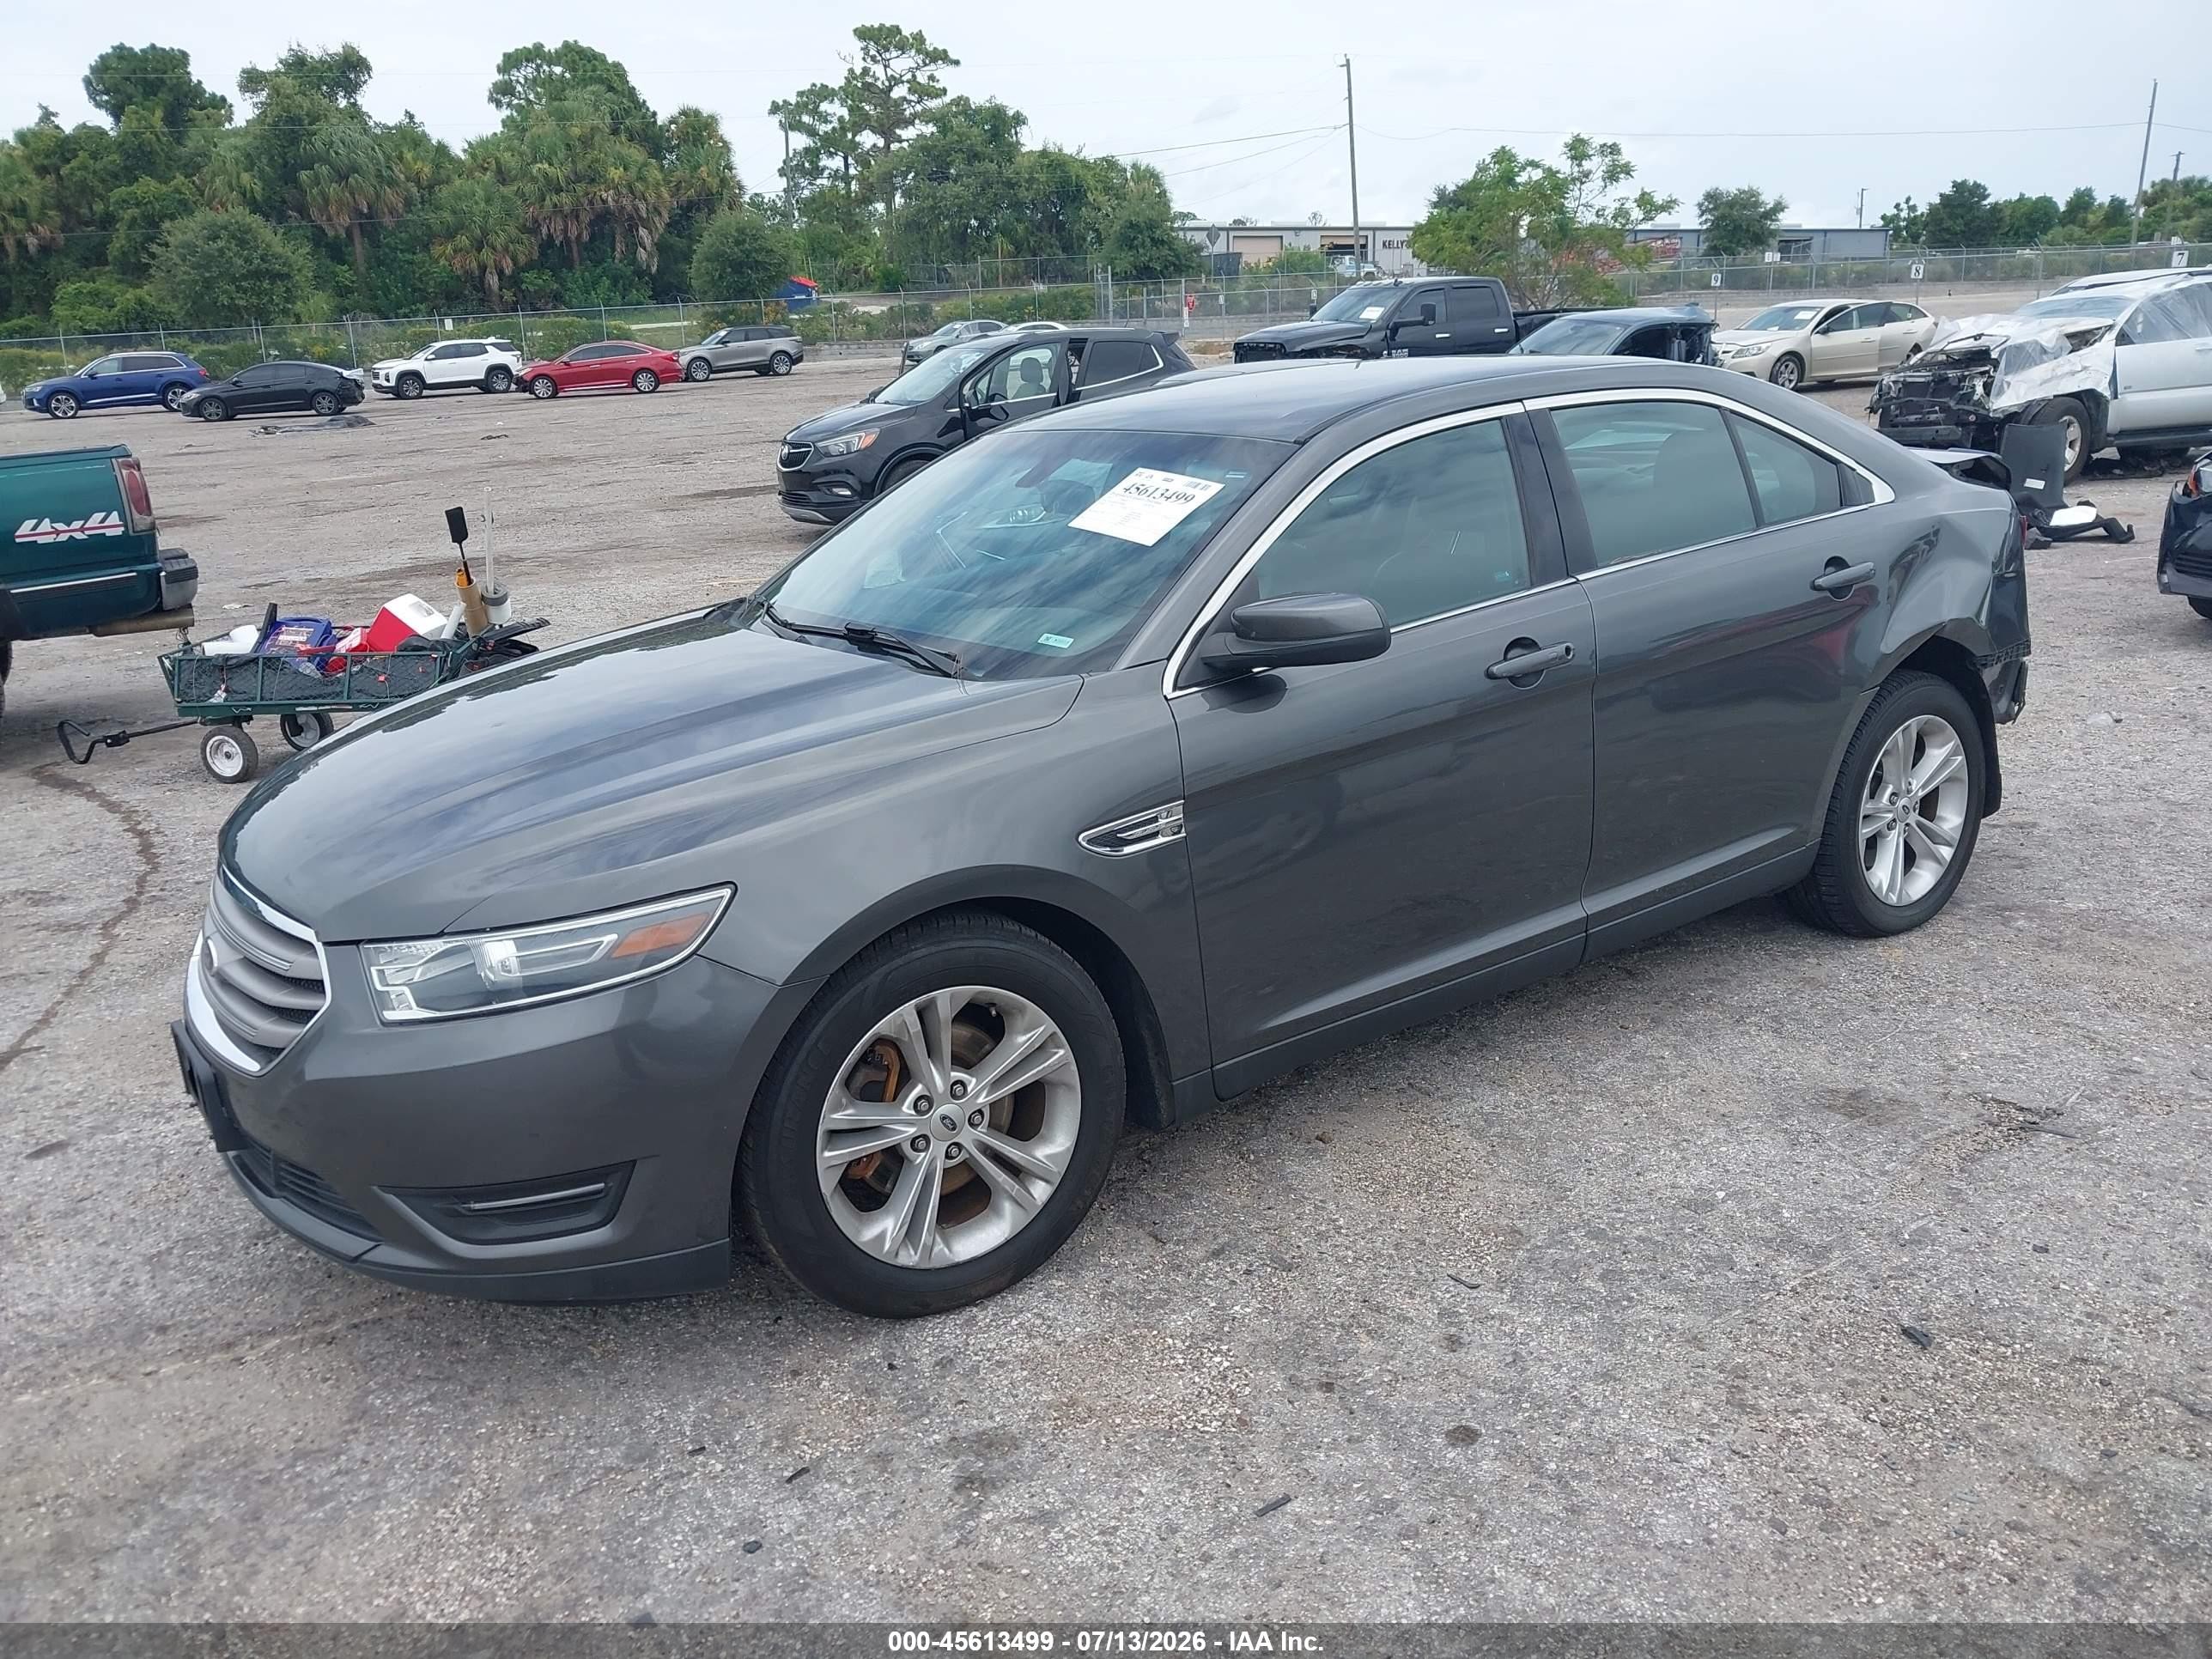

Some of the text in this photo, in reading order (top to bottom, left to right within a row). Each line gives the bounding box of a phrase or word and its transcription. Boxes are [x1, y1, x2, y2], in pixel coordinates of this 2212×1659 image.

[2177, 252, 2185, 266] 7
[1913, 265, 1921, 277] 8
[1122, 482, 1196, 505] 45613499
[14, 510, 125, 544] 4x4
